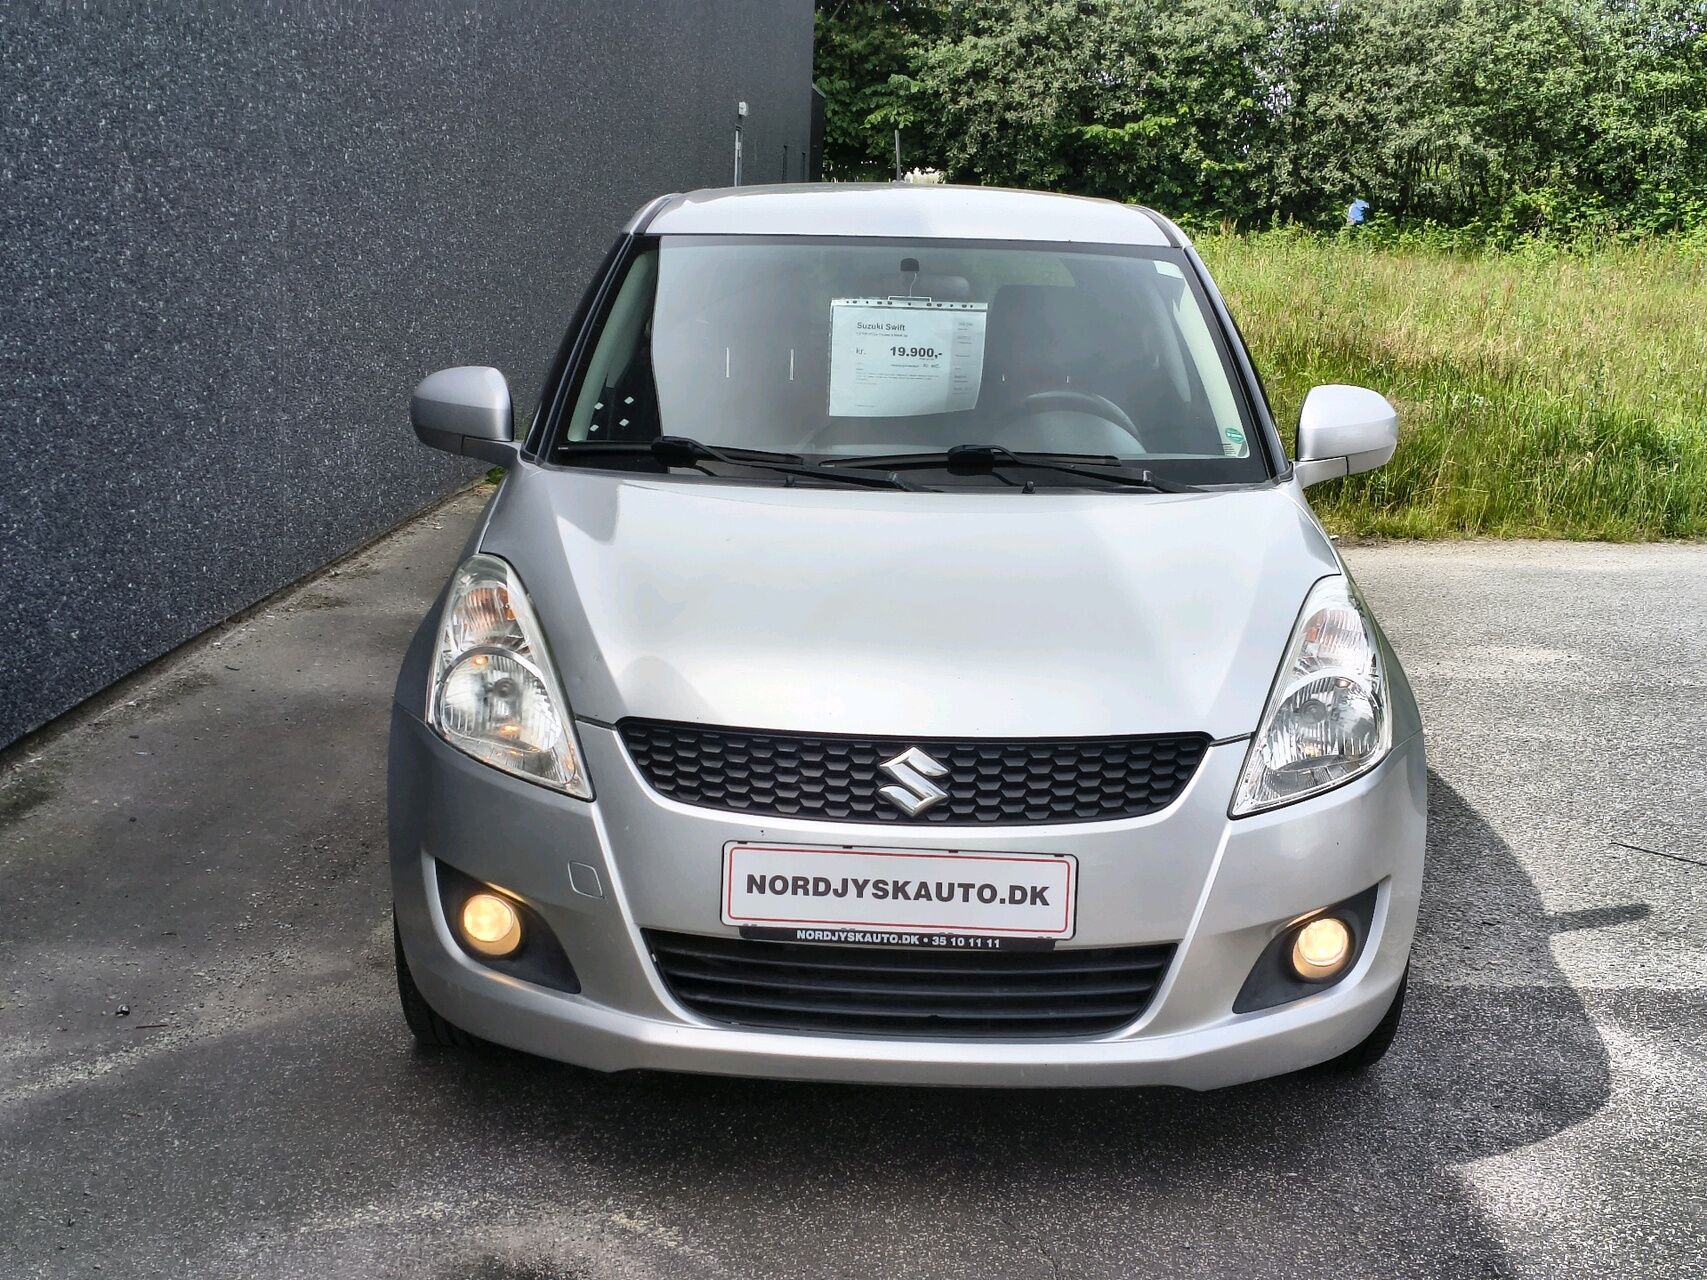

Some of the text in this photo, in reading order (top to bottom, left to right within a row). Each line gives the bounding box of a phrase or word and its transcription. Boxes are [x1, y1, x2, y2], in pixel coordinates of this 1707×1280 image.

[857, 322, 905, 331] Suzuki Swift
[890, 346, 943, 359] 19.900,-
[746, 874, 1050, 906] NORDJYSKAUTO.DK
[797, 929, 1000, 948] NORDJYSKAUTO.DK 35 10 11 11
